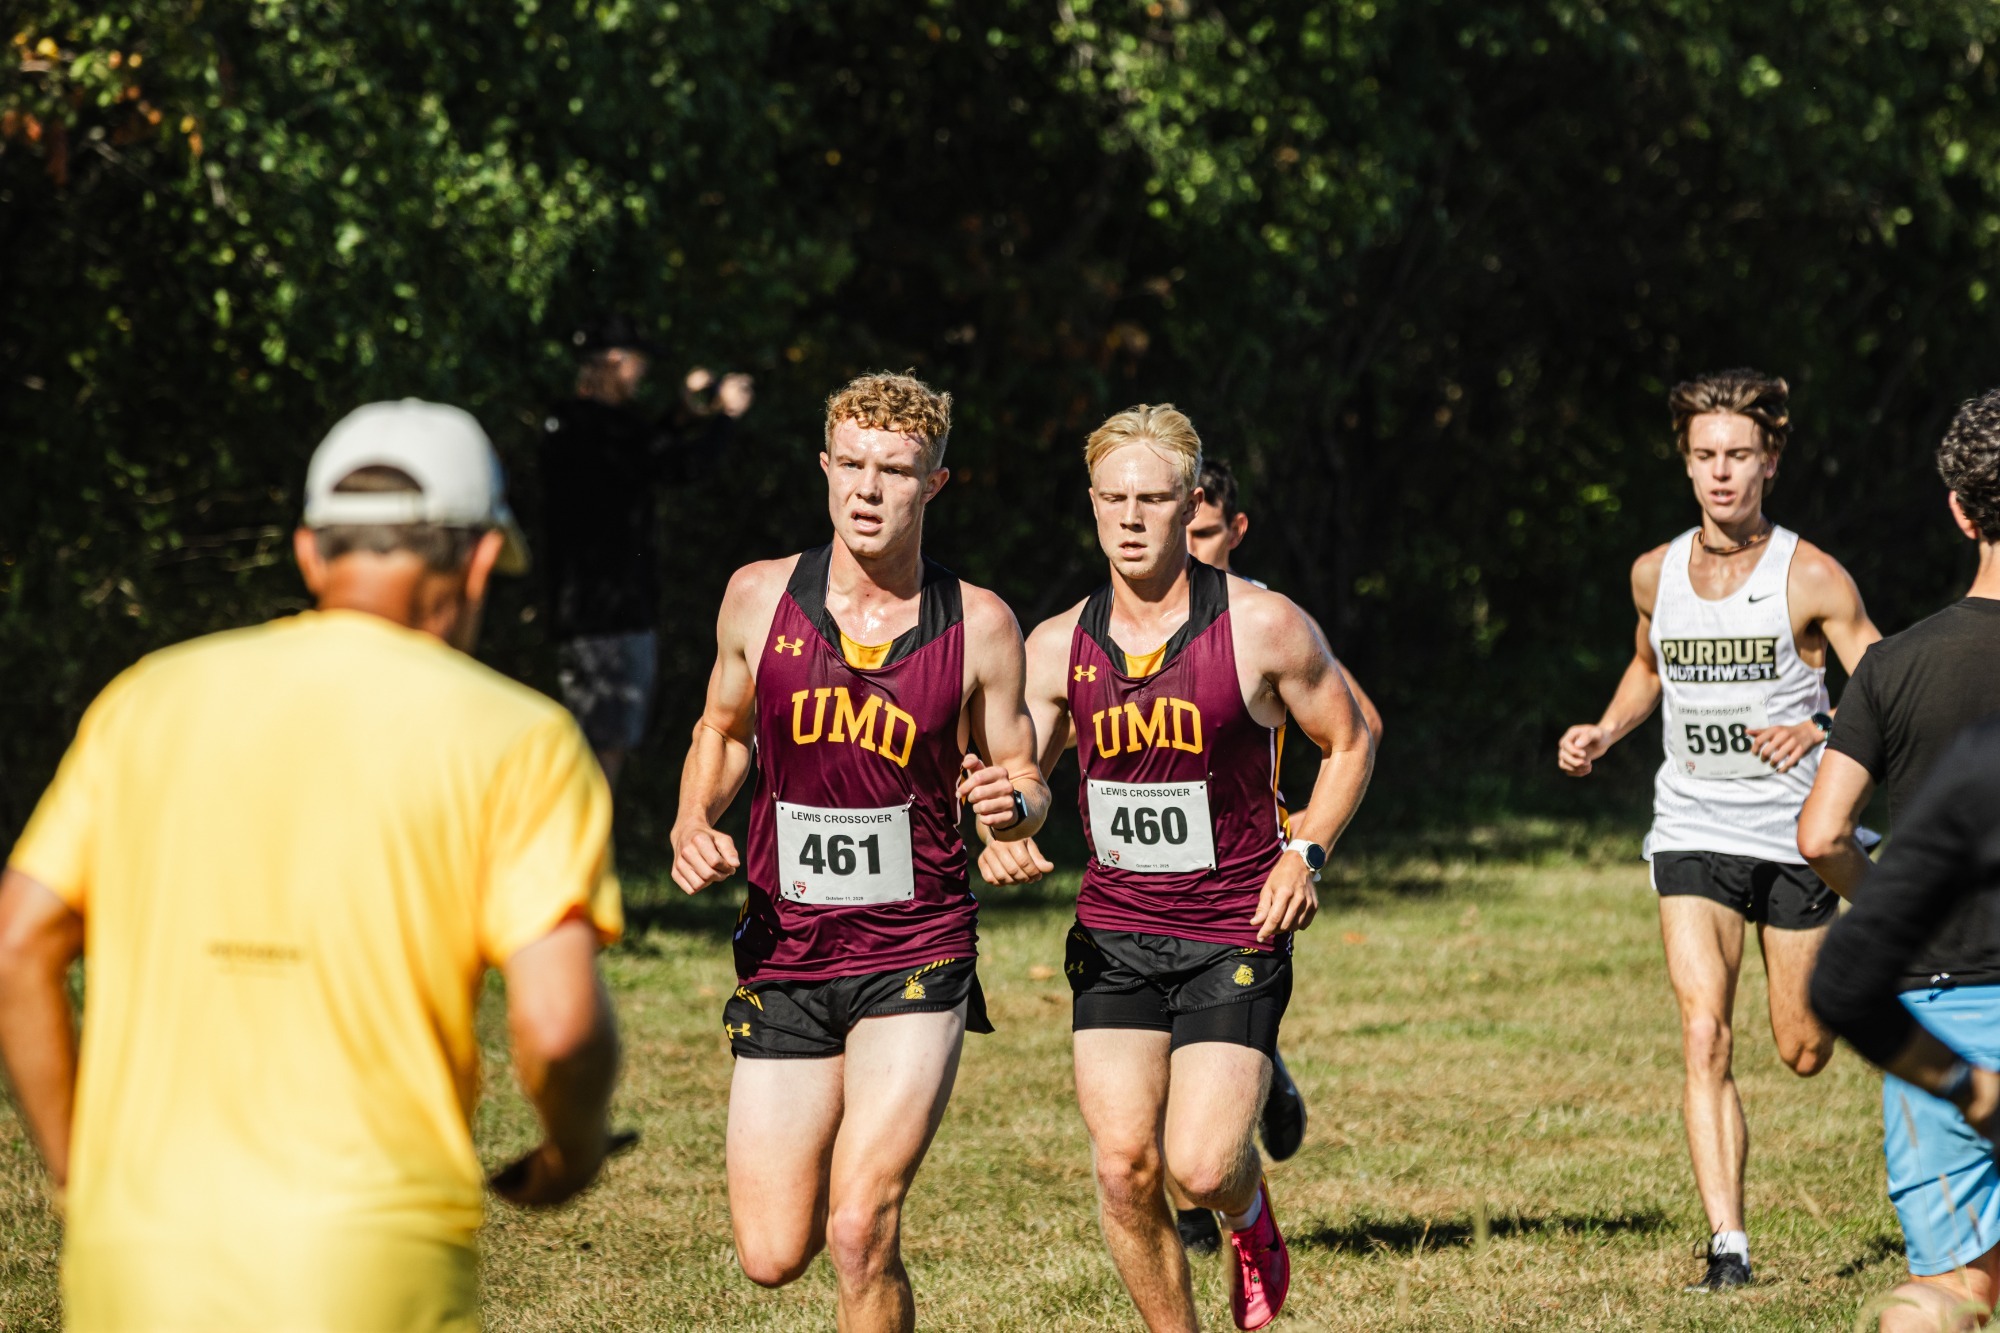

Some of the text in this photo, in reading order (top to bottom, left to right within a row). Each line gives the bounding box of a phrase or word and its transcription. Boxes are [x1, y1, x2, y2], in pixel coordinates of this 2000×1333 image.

[1662, 639, 1774, 664] PURDUE
[1667, 664, 1774, 681] NORTHWEST
[791, 686, 917, 768] UMD
[1092, 697, 1203, 759] UMD
[1685, 722, 1752, 755] 598
[1100, 787, 1191, 798] LEWIS CROSSOVER
[791, 810, 893, 824] LEWIS CROSSOVER
[1110, 806, 1188, 845] 460
[798, 833, 881, 875] 461
